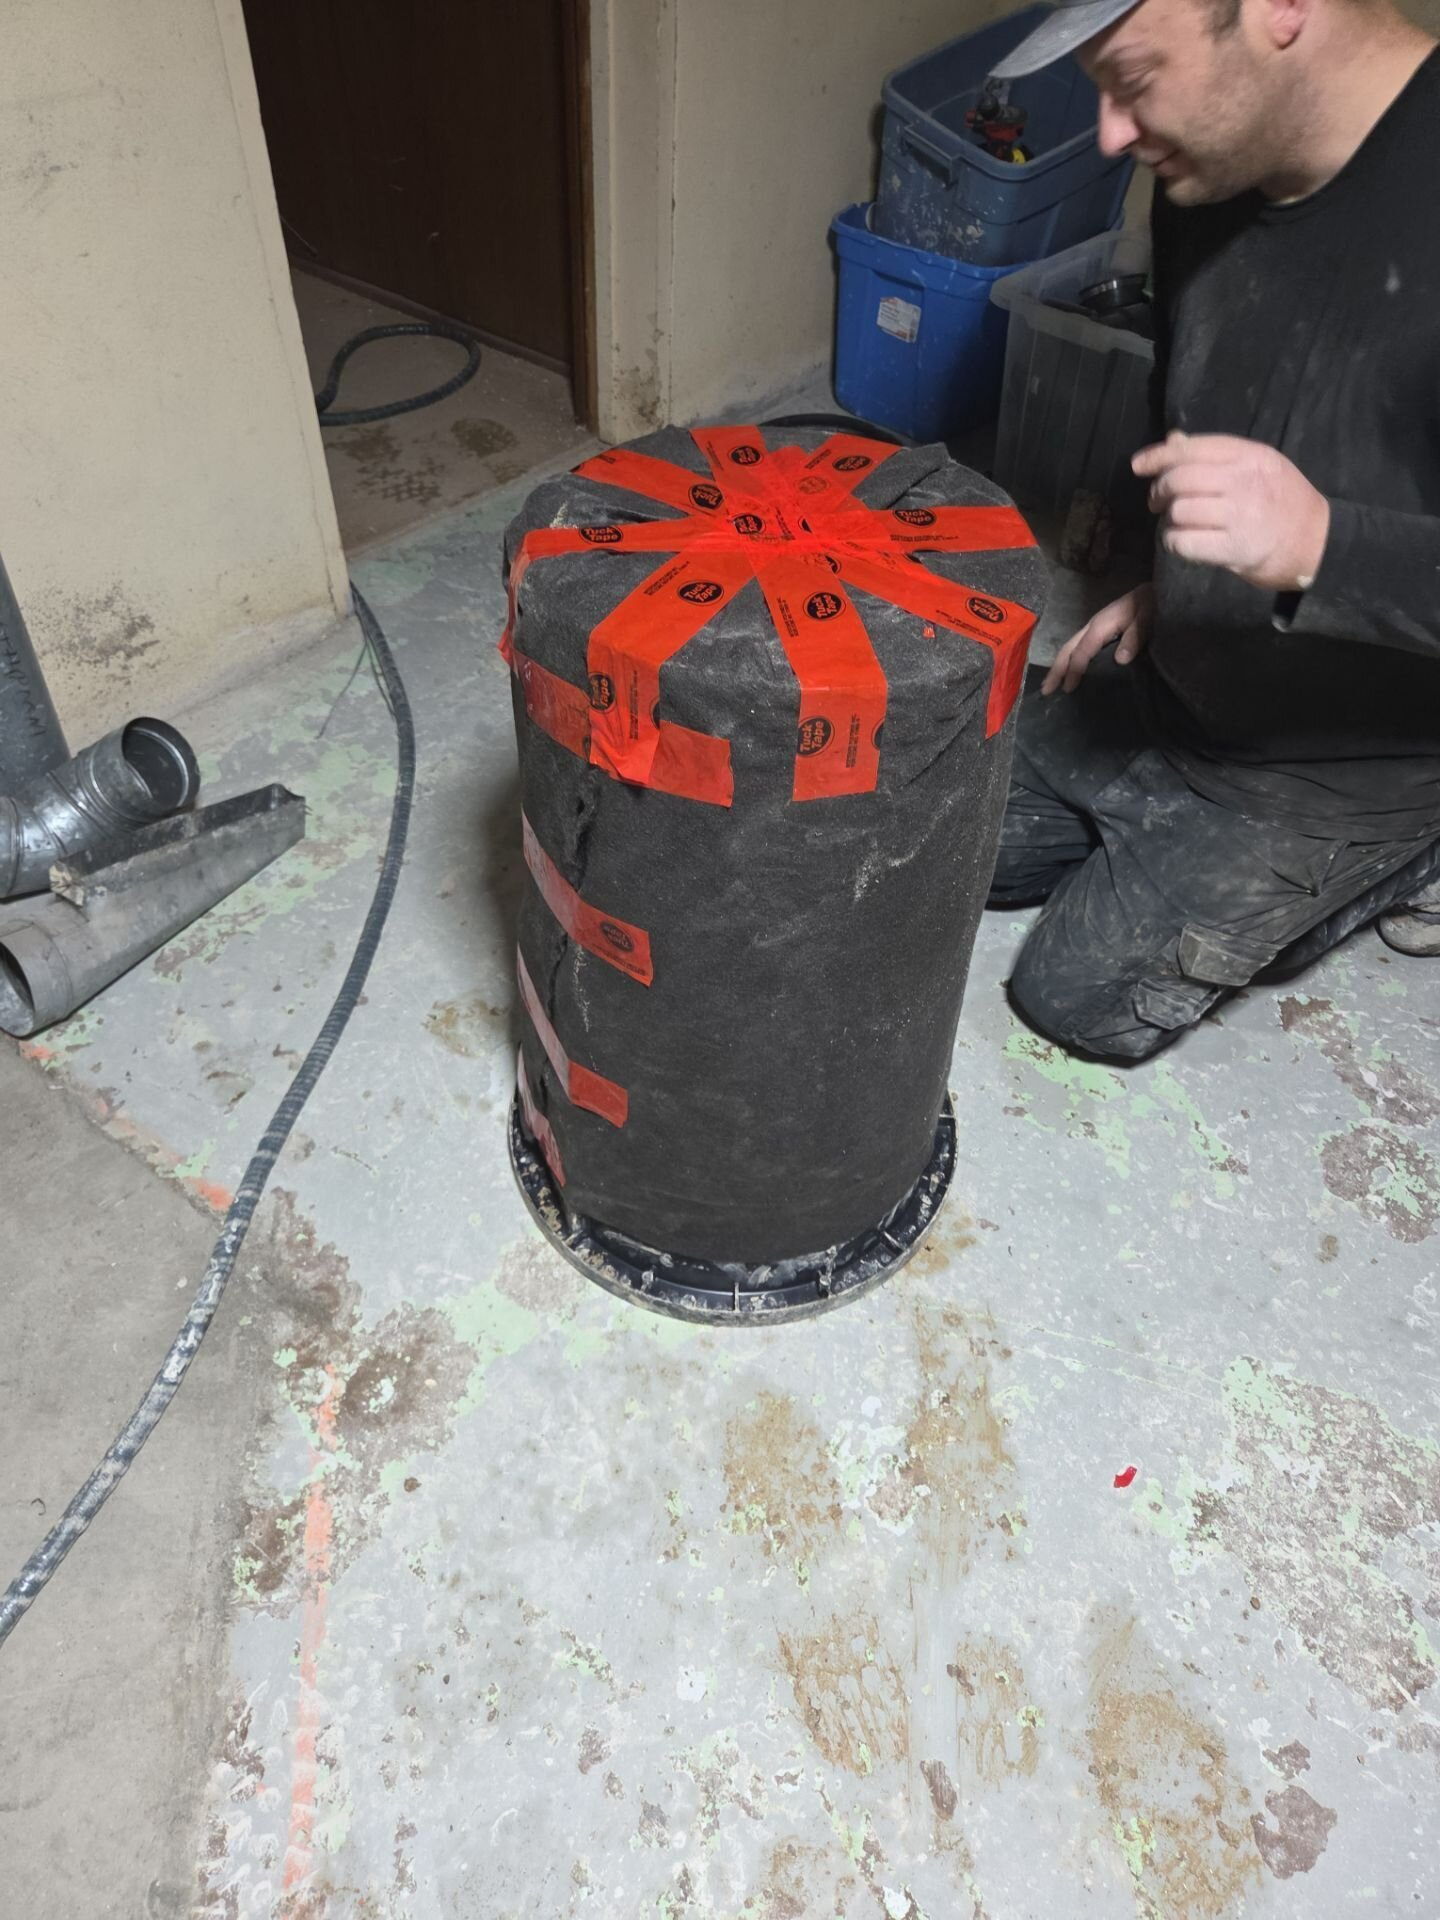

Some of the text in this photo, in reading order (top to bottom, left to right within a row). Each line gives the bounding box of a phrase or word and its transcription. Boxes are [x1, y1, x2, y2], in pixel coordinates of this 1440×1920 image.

[905, 516, 932, 524] Tape
[583, 527, 615, 535] Tuck
[590, 534, 619, 542] Tape
[683, 583, 707, 599] Tuck
[695, 585, 718, 602] Tape
[811, 596, 827, 618] Tuck
[823, 594, 837, 614] Tape
[973, 604, 1000, 621] Tuck
[600, 678, 610, 708] Tape
[800, 722, 812, 752] Tuck
[811, 721, 825, 749] Tape
